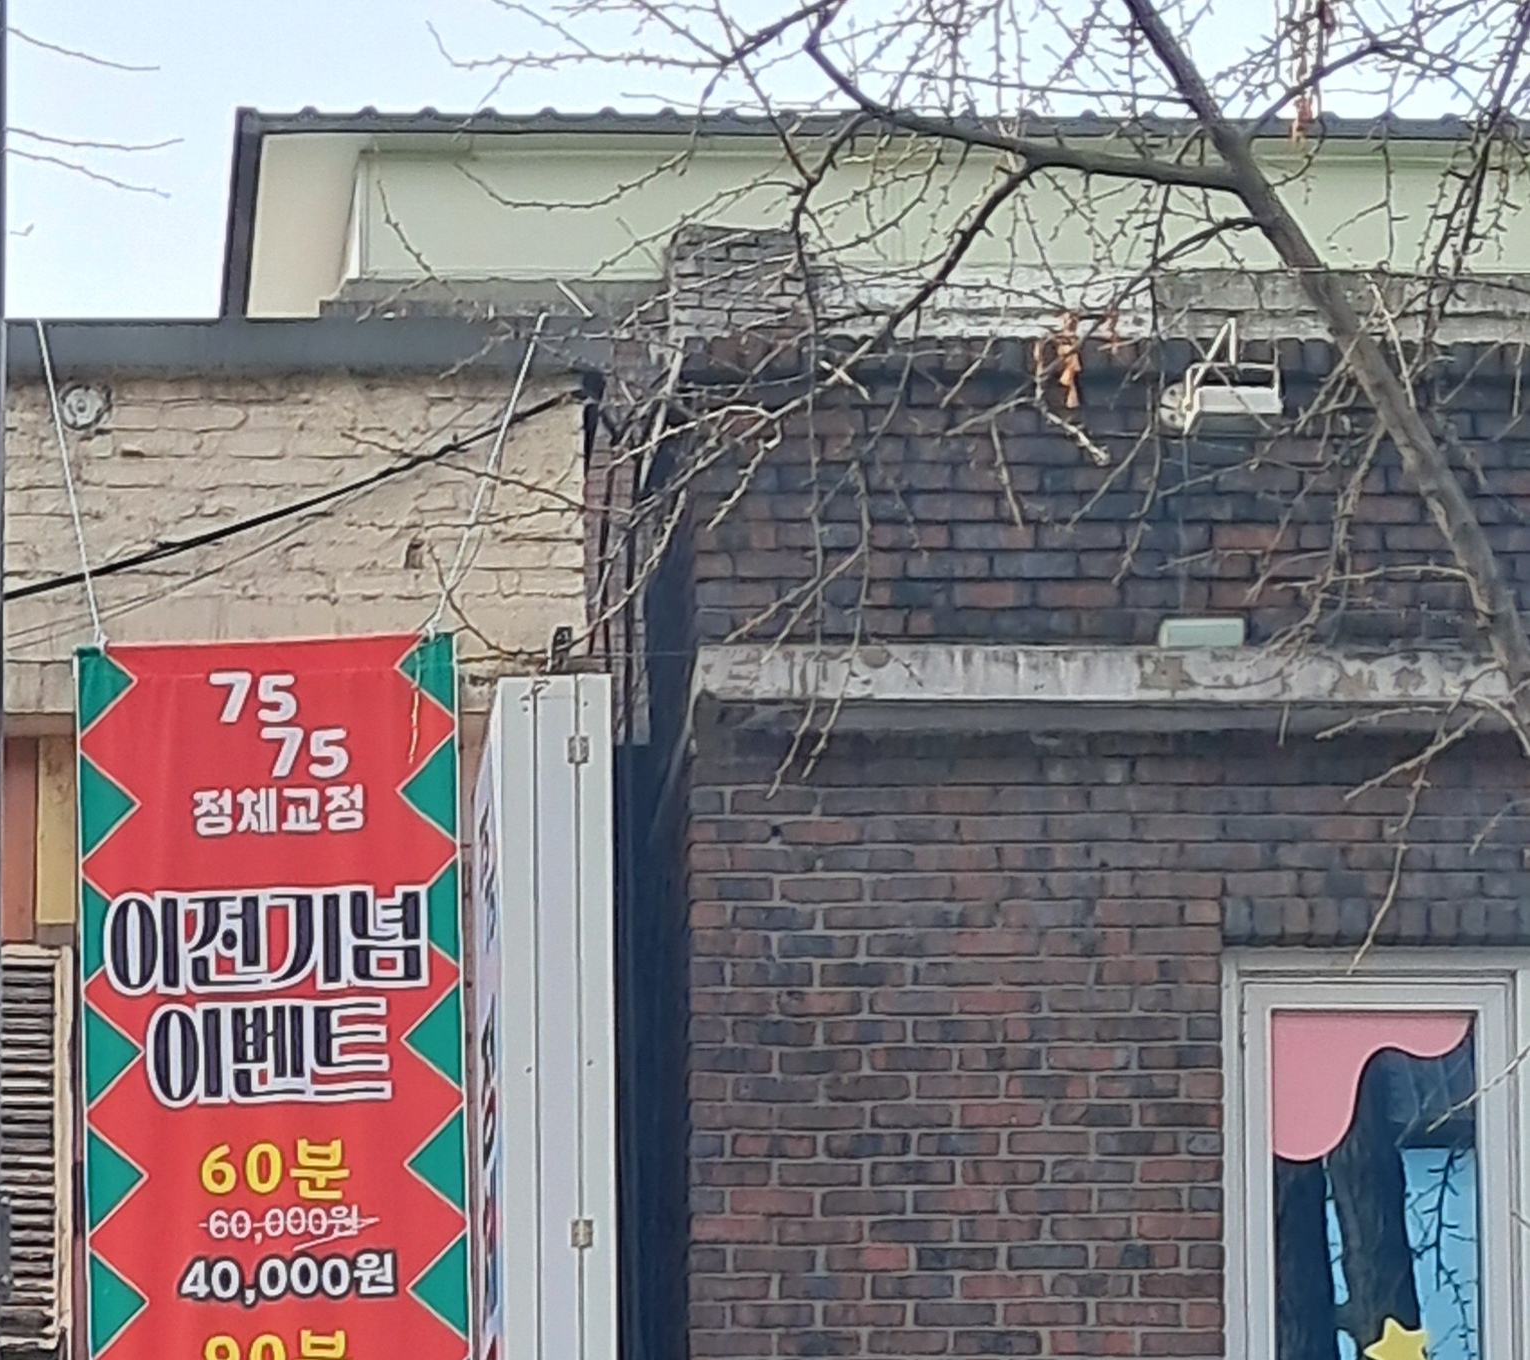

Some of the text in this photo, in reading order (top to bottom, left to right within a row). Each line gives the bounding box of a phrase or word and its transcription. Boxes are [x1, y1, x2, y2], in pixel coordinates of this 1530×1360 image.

[209, 671, 298, 723] 75
[261, 727, 350, 779] 75
[194, 783, 365, 836] 정체교정
[104, 885, 429, 995] 이전기념
[146, 997, 392, 1108] 이벤트
[200, 1138, 351, 1200] 60분
[208, 1205, 359, 1245] 60,000원
[180, 1254, 396, 1306] 40,000원
